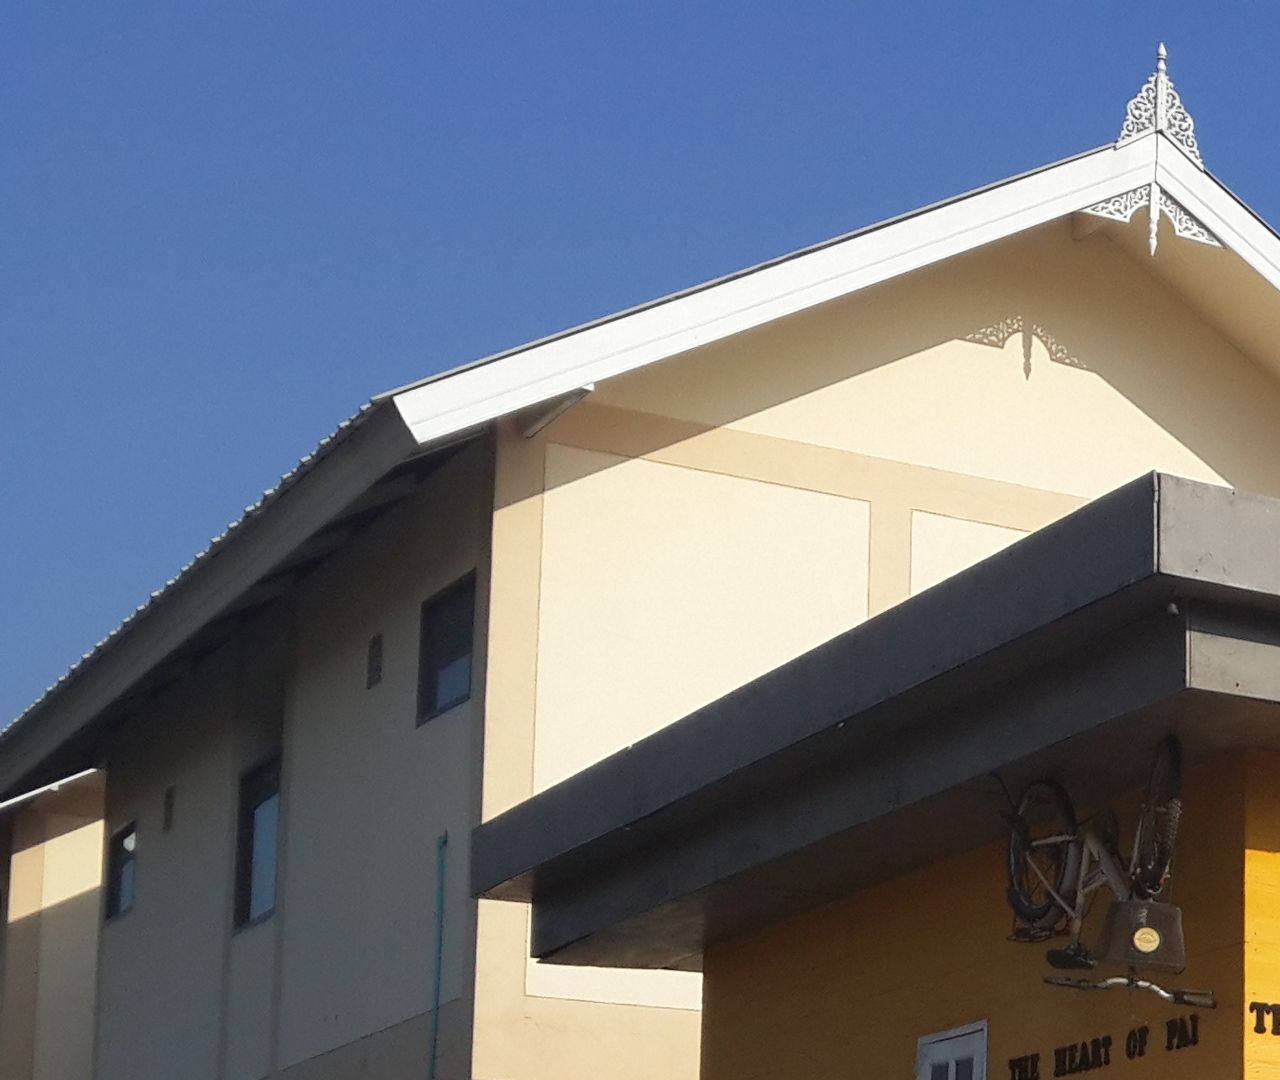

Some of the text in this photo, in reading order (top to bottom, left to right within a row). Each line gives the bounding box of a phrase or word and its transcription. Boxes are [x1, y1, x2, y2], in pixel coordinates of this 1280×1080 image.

[1053, 1035, 1112, 1078] HEART
[1125, 1025, 1150, 1060] OF
[1165, 1014, 1200, 1051] PAI
